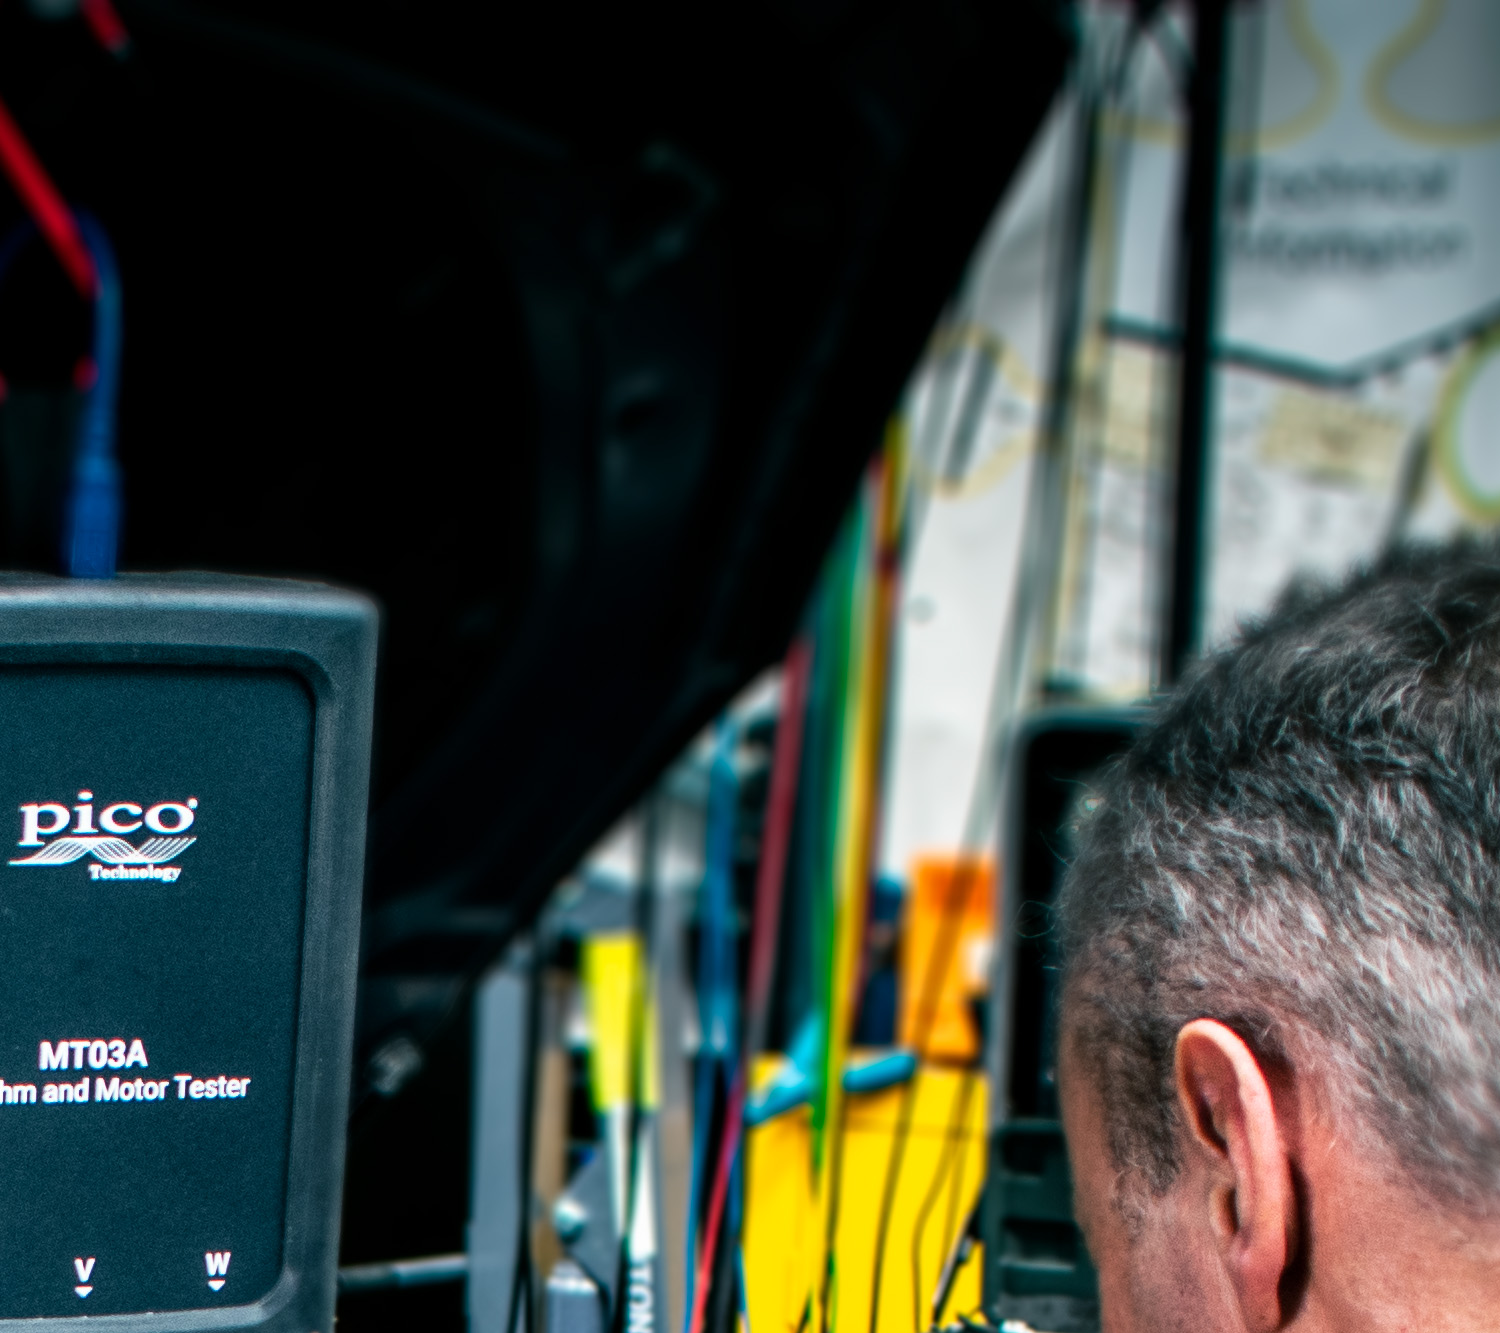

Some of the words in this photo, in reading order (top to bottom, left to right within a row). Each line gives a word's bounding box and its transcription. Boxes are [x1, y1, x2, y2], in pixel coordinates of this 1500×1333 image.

[18, 789, 196, 846] pico
[89, 863, 182, 881] Technology
[39, 1039, 148, 1071] MT03A
[42, 1079, 88, 1104] and
[95, 1078, 169, 1102] Motor
[173, 1074, 251, 1101] Tester
[74, 1258, 95, 1281] V
[206, 1252, 231, 1277] W
